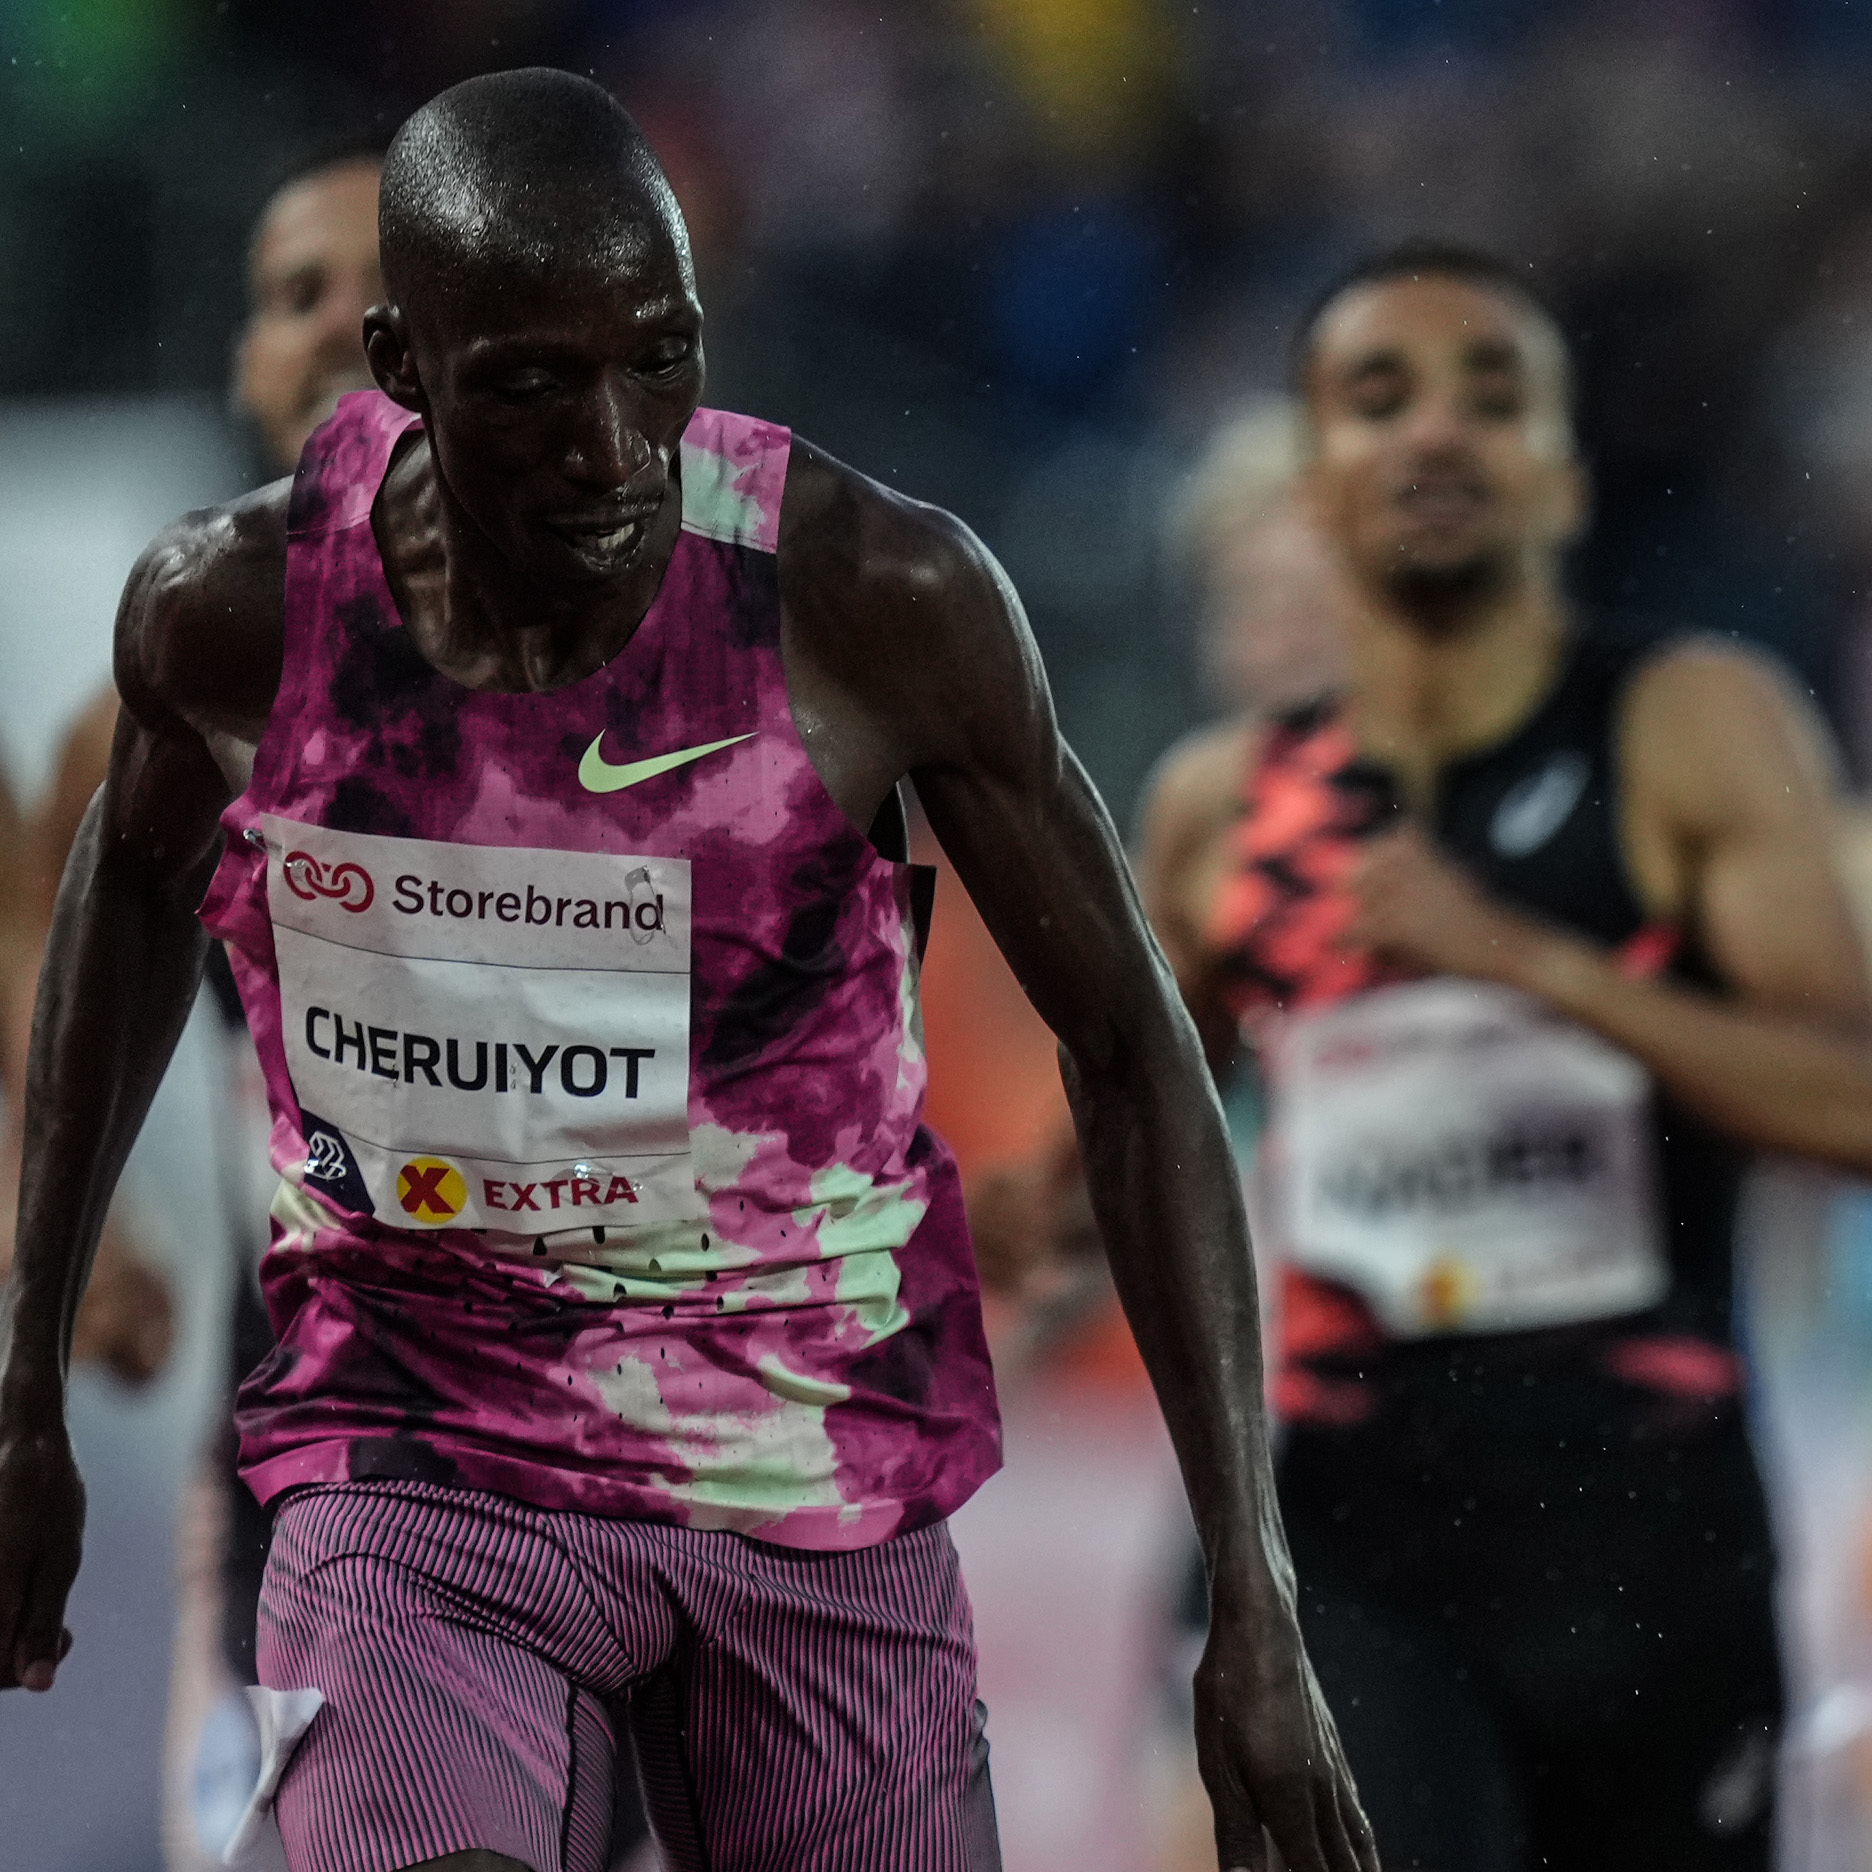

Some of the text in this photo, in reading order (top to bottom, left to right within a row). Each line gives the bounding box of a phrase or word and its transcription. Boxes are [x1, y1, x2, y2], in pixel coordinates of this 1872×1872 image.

[392, 874, 665, 932] Storebrand
[305, 1005, 656, 1100] CHERUIYOT
[482, 1175, 640, 1213] EXTRA
